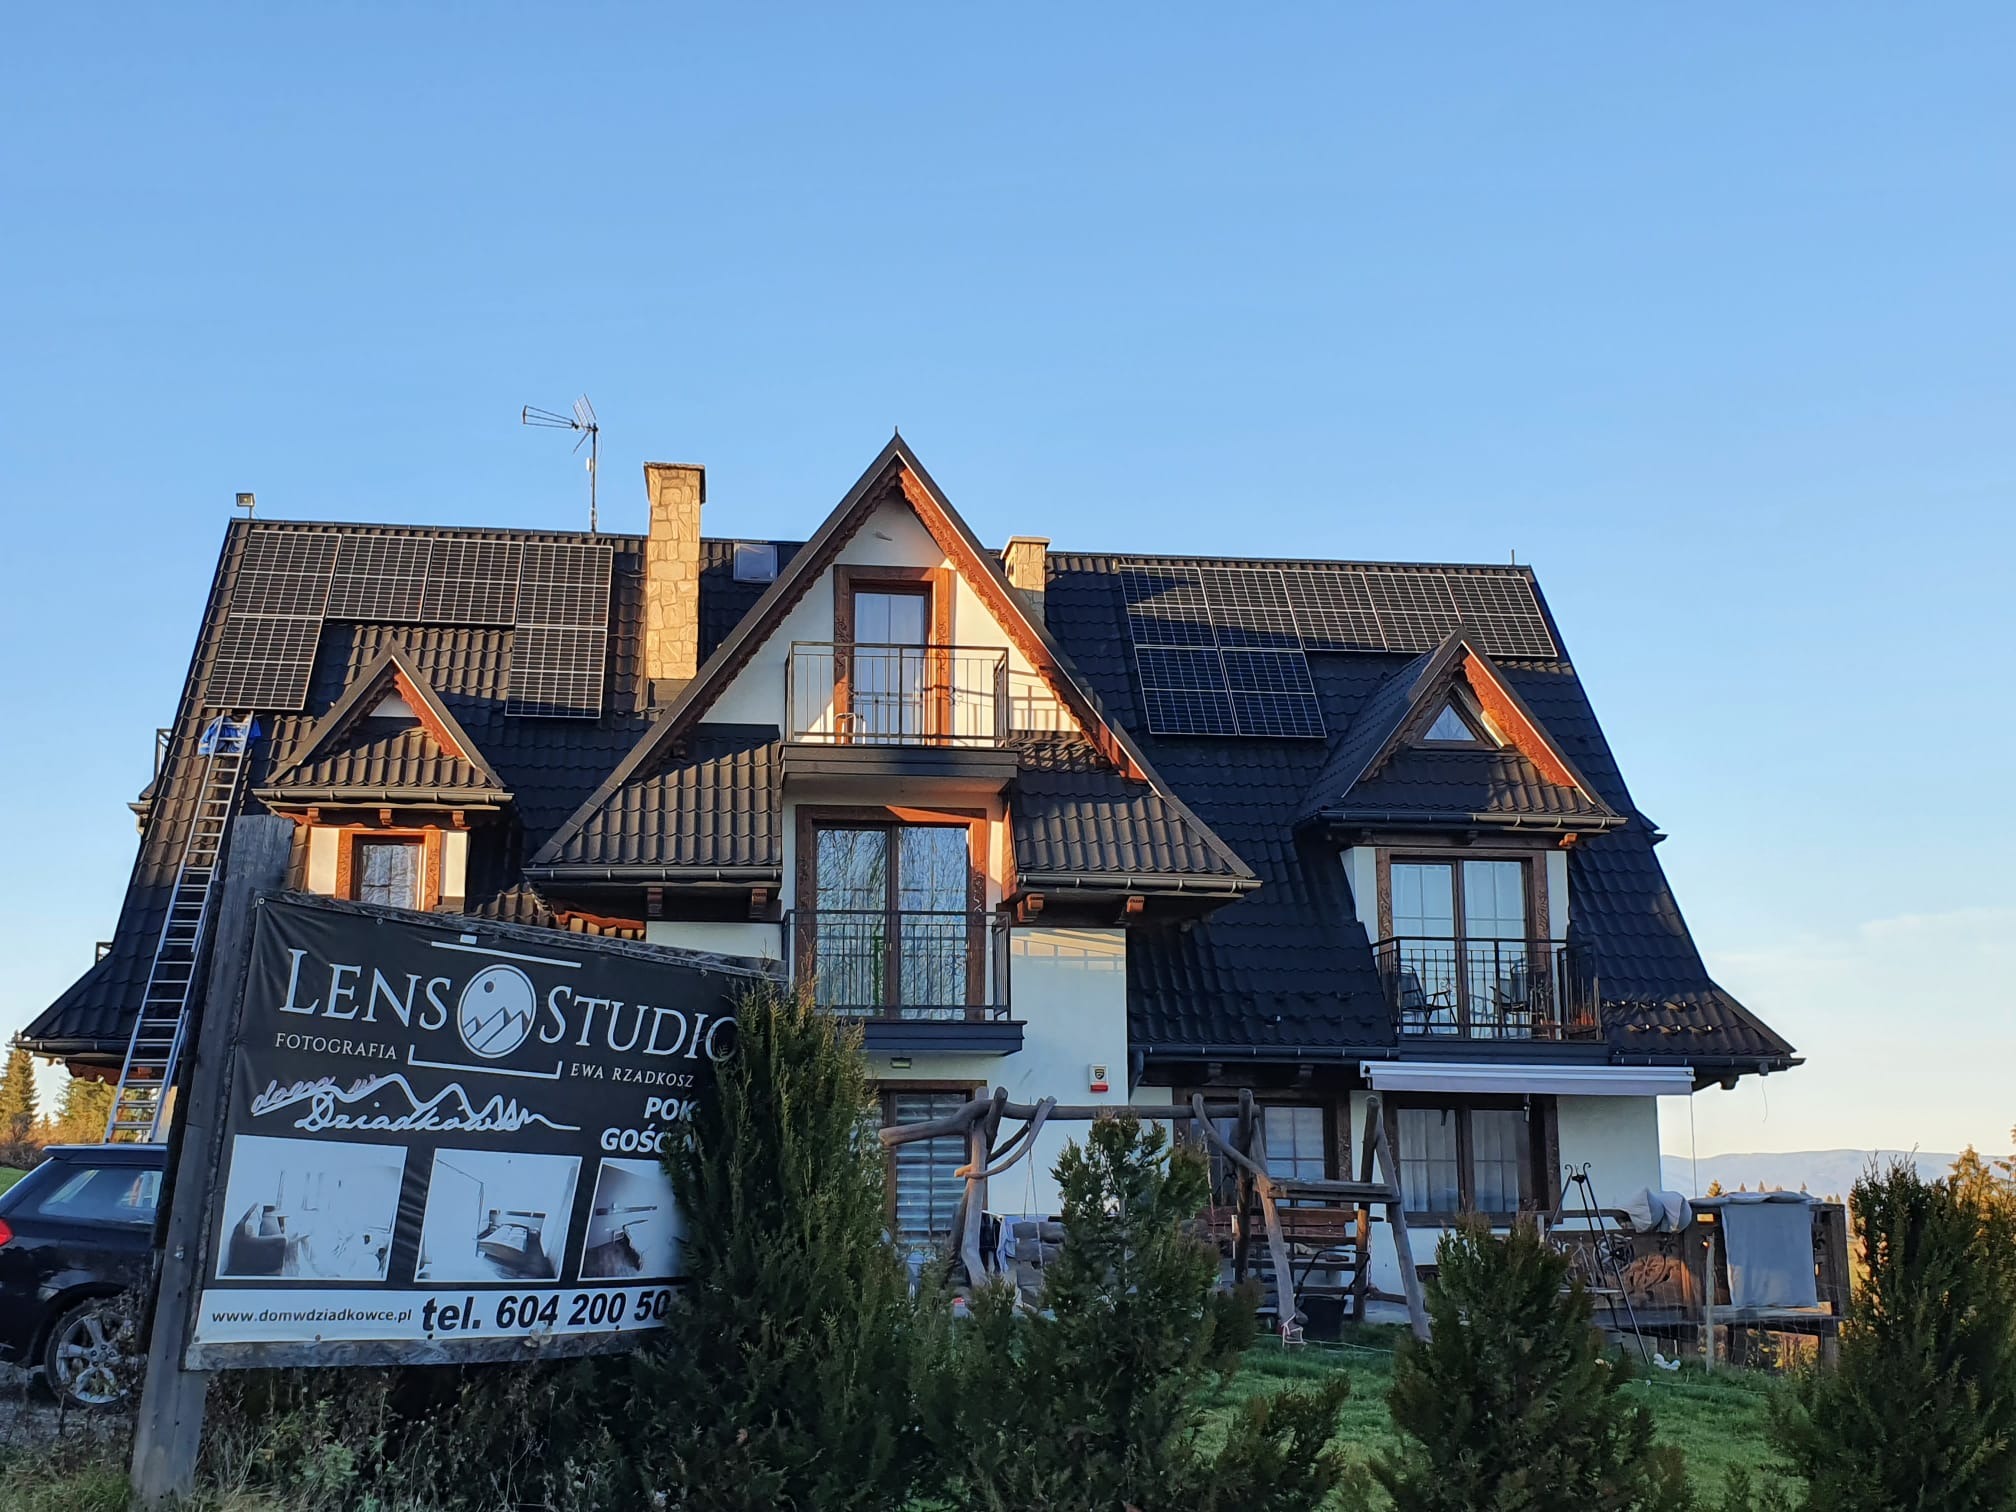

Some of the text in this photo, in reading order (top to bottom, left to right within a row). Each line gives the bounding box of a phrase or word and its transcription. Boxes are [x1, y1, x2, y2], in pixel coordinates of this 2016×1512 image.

[280, 948, 738, 1063] LENS STUDIO
[275, 1033, 397, 1060] FOTOGRAFIA
[570, 1063, 695, 1088] EWA RZADKOSZ
[212, 1308, 412, 1324] www.domwdziadkowce.pl
[422, 1289, 684, 1331] tel. 604 200 50
